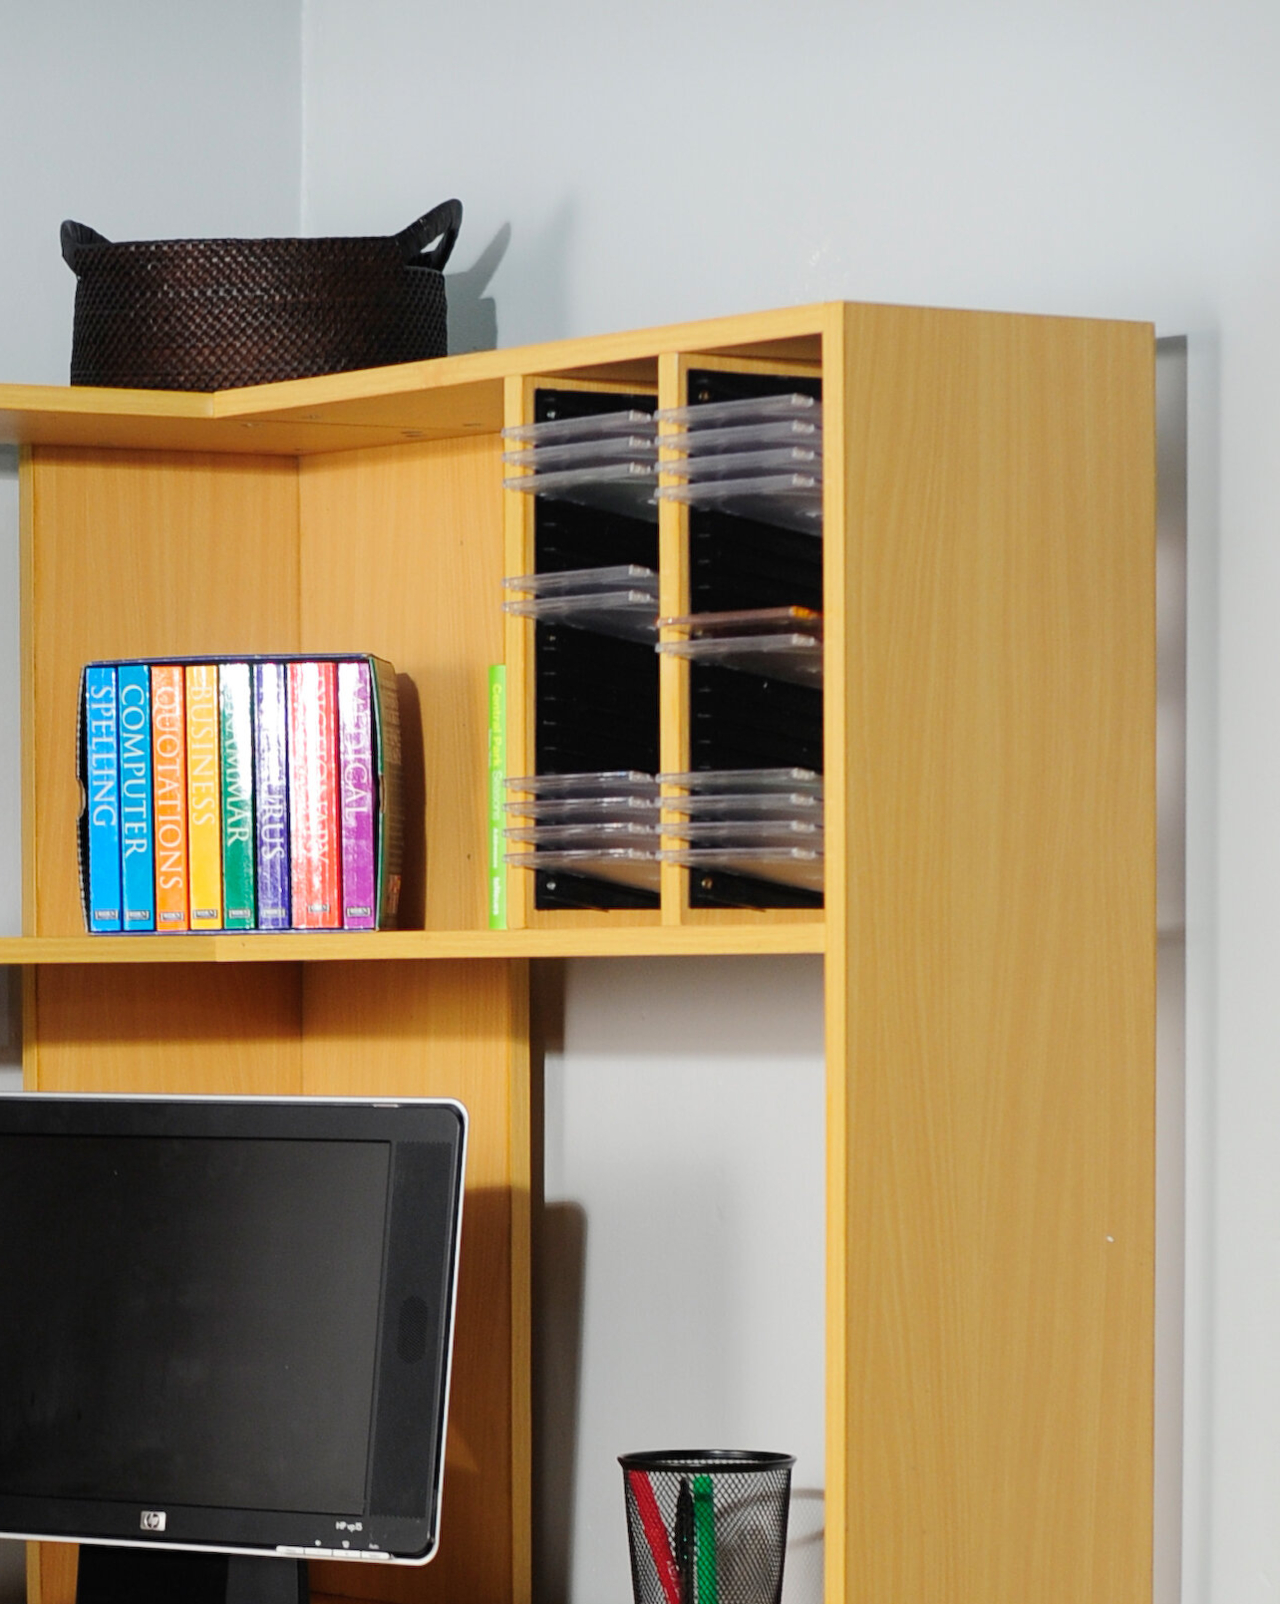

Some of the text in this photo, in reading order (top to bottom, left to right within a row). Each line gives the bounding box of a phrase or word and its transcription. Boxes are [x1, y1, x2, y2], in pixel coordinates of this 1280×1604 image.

[90, 685, 117, 828] SPELLING
[121, 683, 148, 858] COMPUTER
[154, 686, 183, 890] QUOTATIONS
[190, 685, 215, 826] BUSINESS
[225, 688, 250, 847] AMMAR
